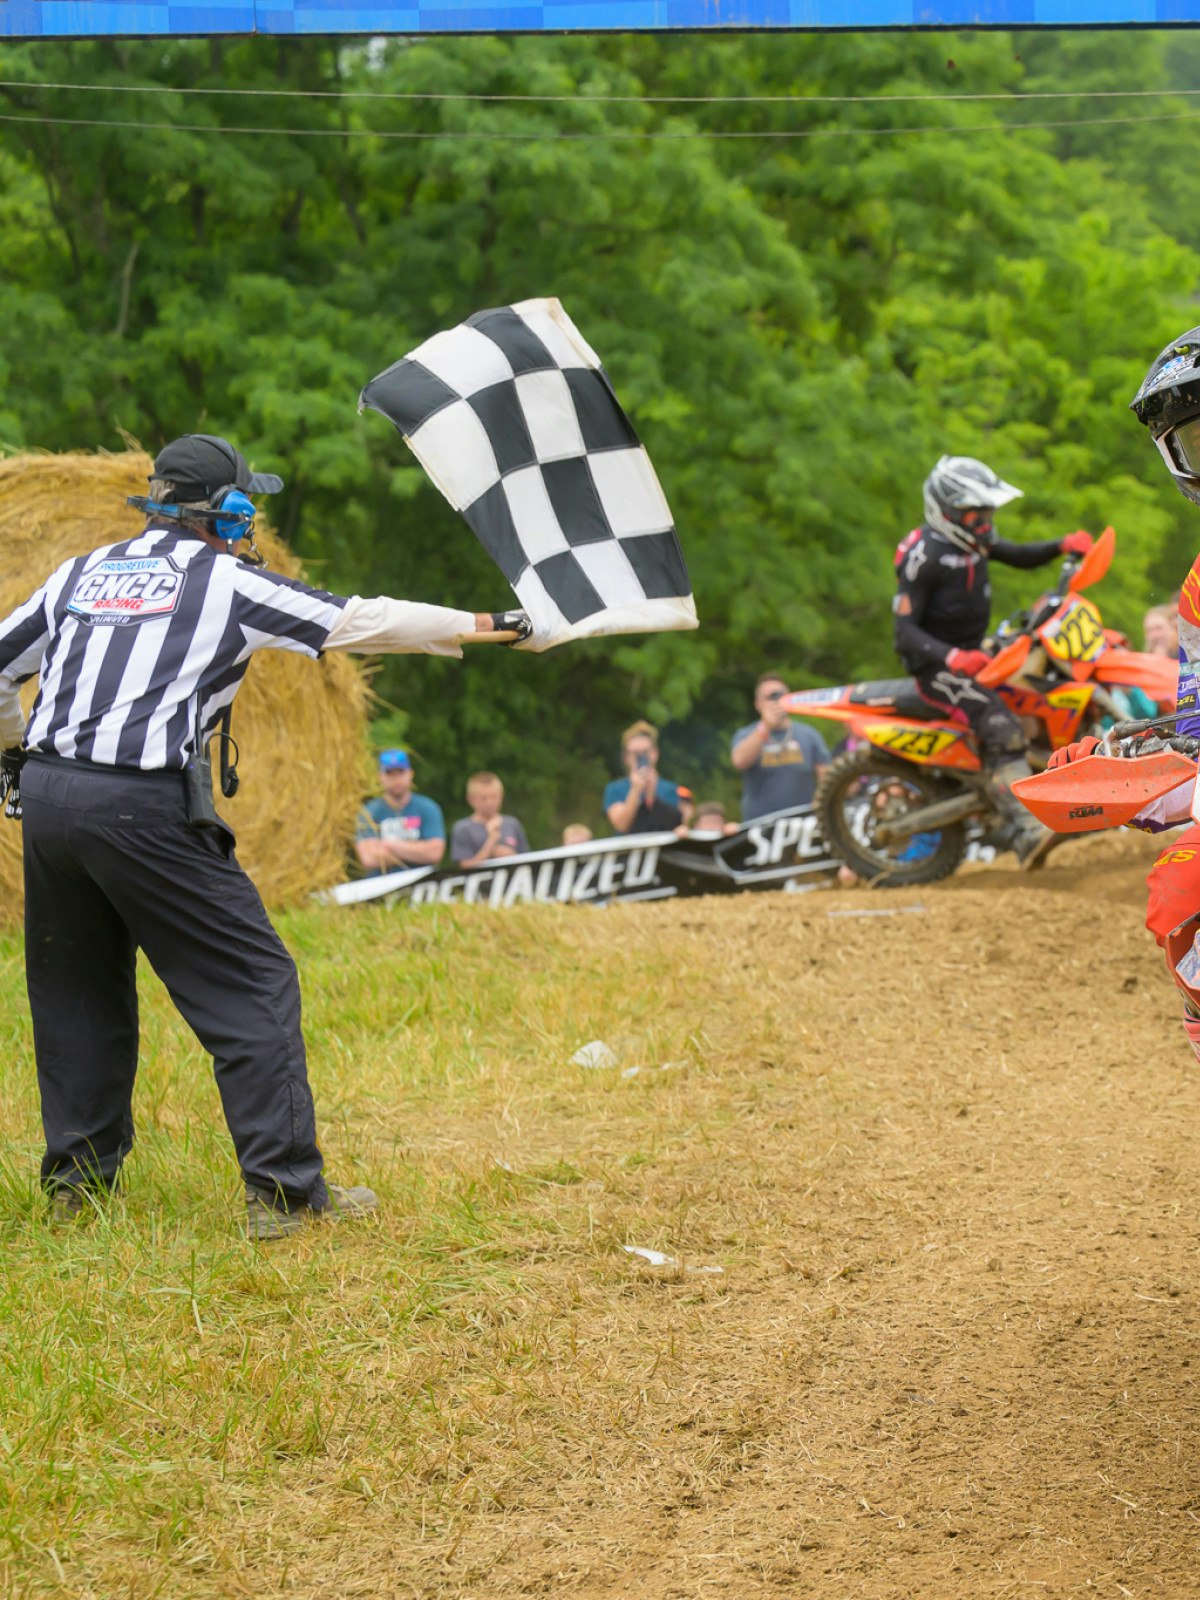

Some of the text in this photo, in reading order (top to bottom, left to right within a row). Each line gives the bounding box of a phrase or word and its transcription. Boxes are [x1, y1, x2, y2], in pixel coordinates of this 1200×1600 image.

[98, 560, 160, 572] PROGRESSIVE
[74, 571, 178, 602] GNCC
[91, 598, 145, 610] RACING
[407, 847, 661, 908] PECIALIZED
